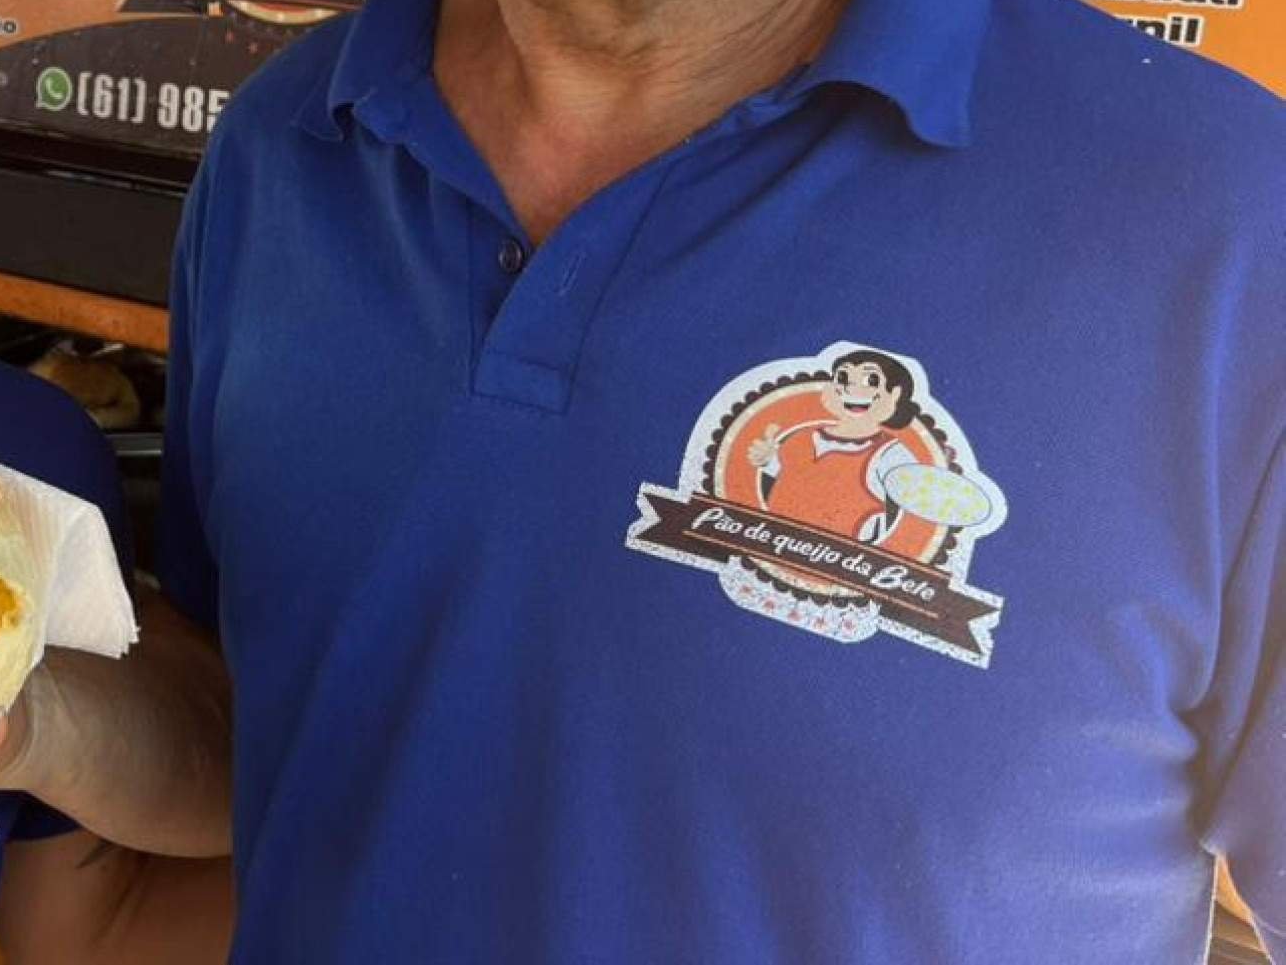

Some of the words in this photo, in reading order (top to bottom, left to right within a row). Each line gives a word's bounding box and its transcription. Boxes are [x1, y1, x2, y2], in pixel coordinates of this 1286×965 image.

[76, 71, 147, 125] (61)
[157, 82, 231, 134] 985
[691, 506, 743, 534] Pão
[743, 521, 772, 543] de
[774, 533, 841, 565] queijo
[841, 552, 873, 578] da
